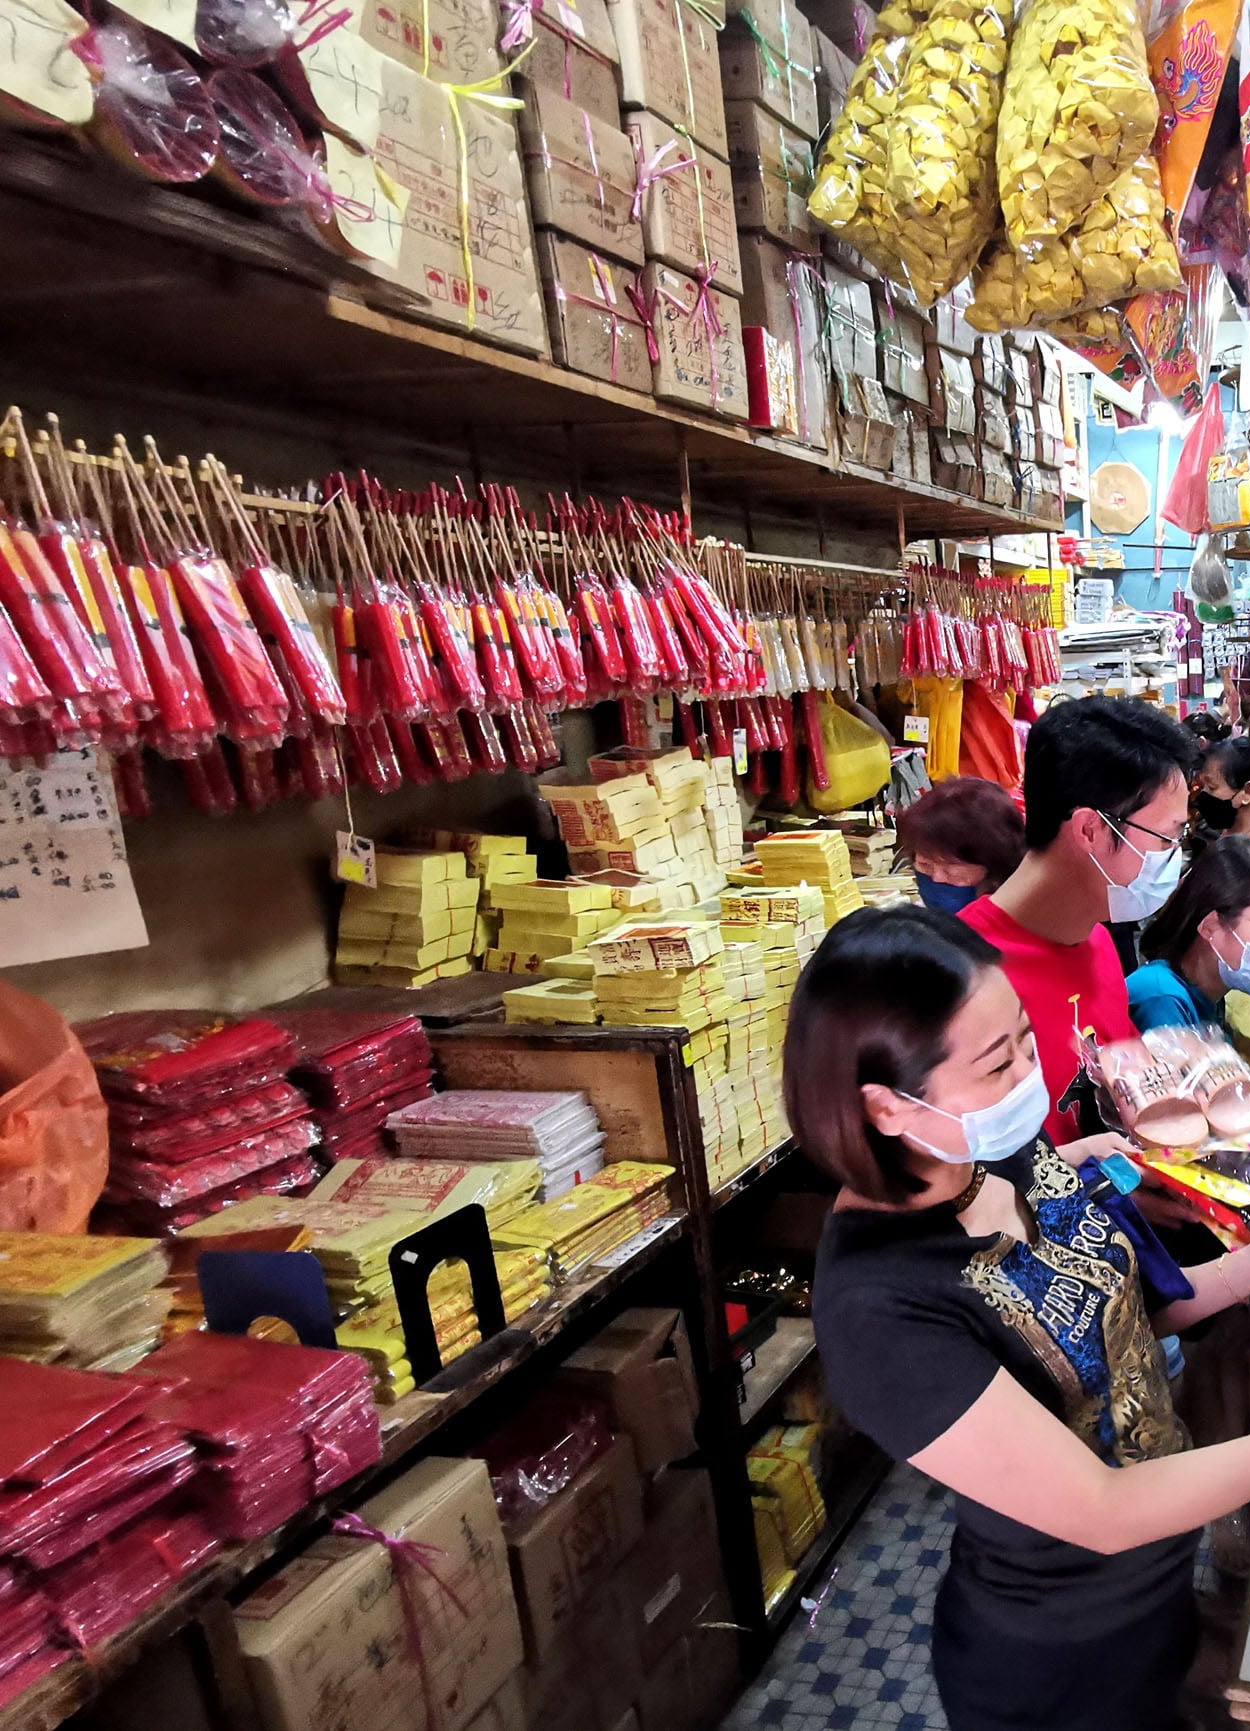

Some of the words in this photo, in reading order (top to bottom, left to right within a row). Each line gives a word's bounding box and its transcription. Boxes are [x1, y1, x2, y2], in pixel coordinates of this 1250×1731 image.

[1037, 1275, 1085, 1337] HARD
[1070, 1203, 1111, 1259] ROC
[1068, 1292, 1101, 1344] COUTURE
